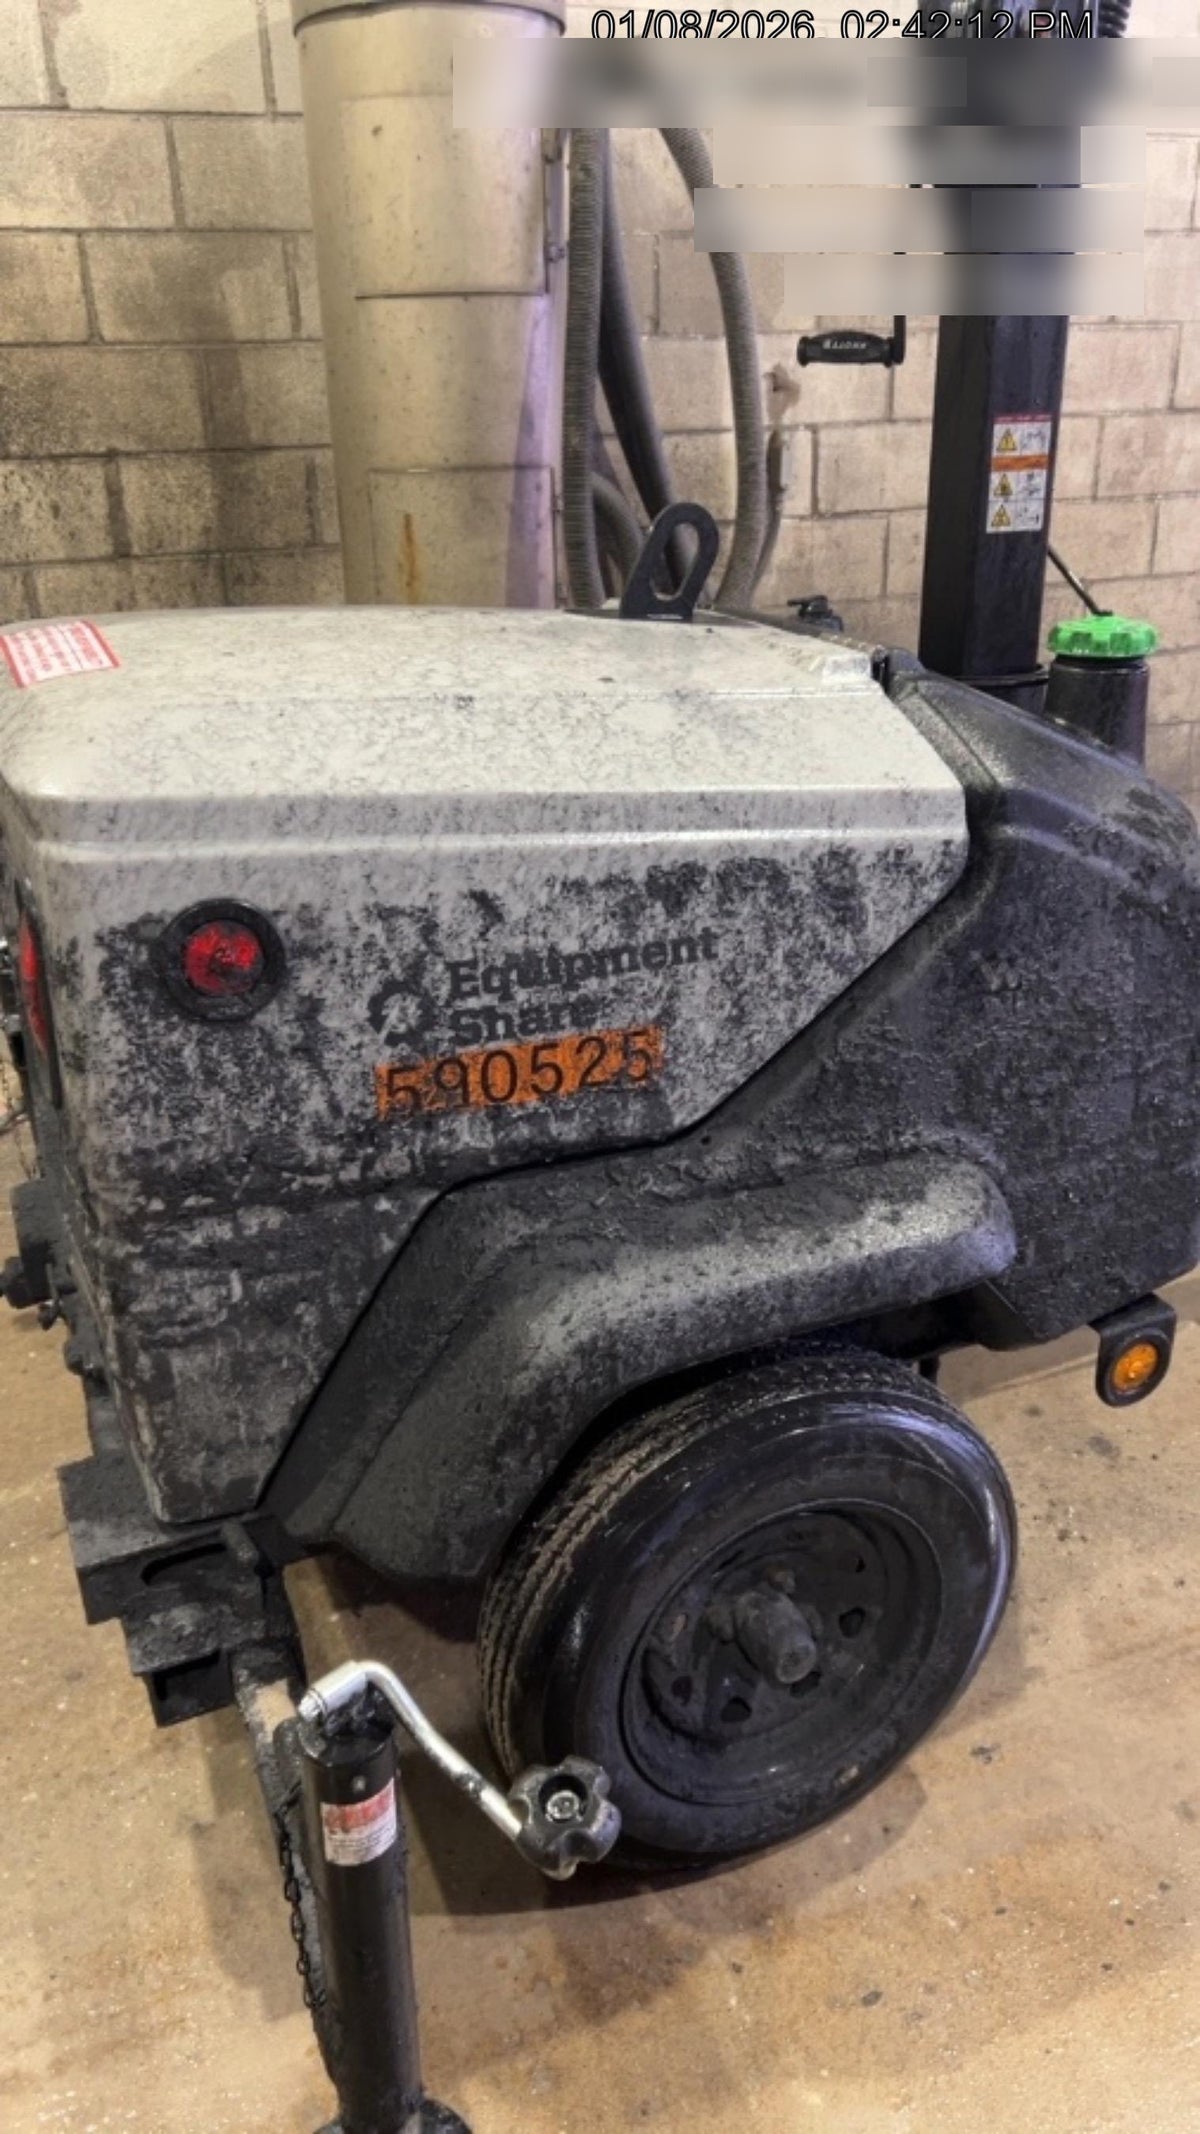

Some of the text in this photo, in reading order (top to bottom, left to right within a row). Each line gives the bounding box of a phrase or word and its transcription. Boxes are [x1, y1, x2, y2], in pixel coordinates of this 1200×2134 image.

[446, 927, 720, 1002] Equipment
[449, 999, 603, 1045] Share
[385, 1030, 654, 1115] 590525
